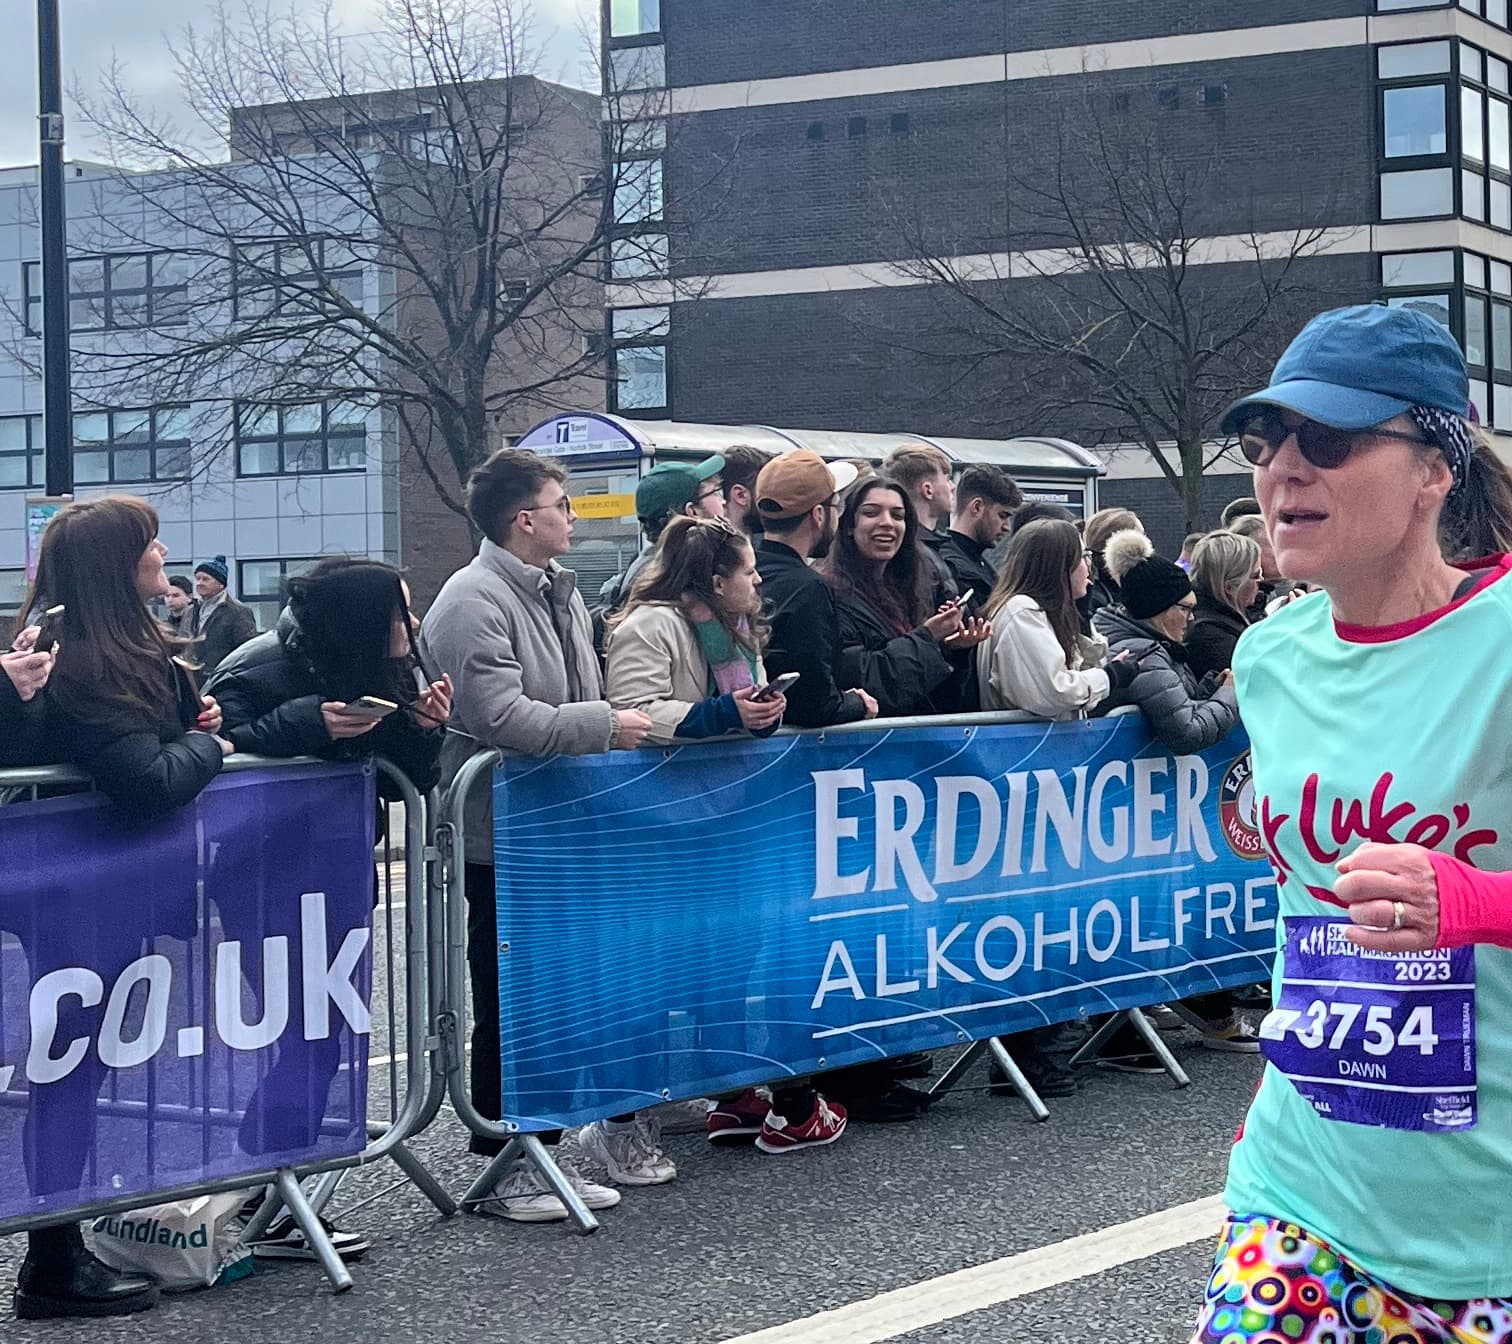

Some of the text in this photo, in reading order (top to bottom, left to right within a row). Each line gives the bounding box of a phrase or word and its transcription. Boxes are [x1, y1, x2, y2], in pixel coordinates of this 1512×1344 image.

[810, 754, 1218, 903] ERDINGER
[810, 875, 1280, 1010] ALKOHOLFRE
[1395, 962, 1451, 981] 2023
[1338, 1059, 1387, 1079] DAWN
